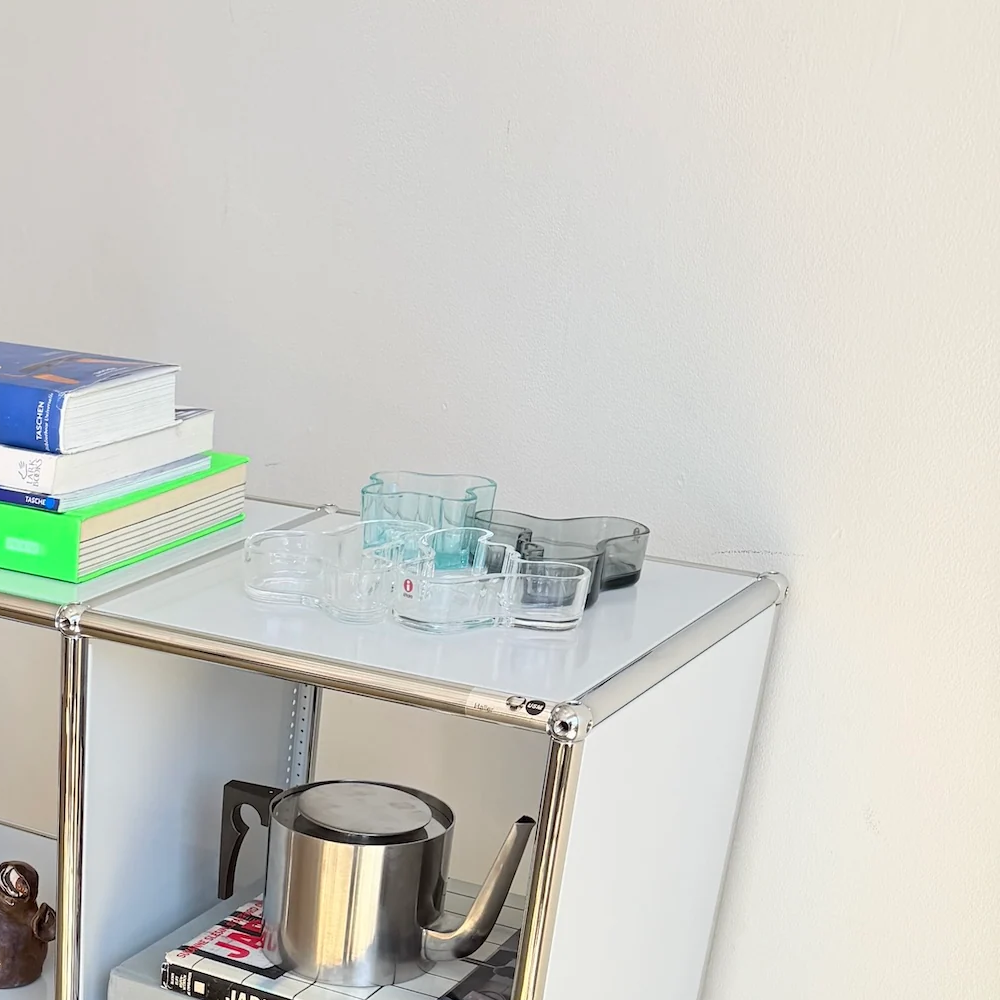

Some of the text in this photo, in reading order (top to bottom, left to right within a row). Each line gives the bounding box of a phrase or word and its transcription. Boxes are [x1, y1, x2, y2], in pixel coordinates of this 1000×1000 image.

[36, 401, 45, 441] TASCHEN
[25, 495, 47, 506] TASCHE
[527, 702, 544, 711] USM
